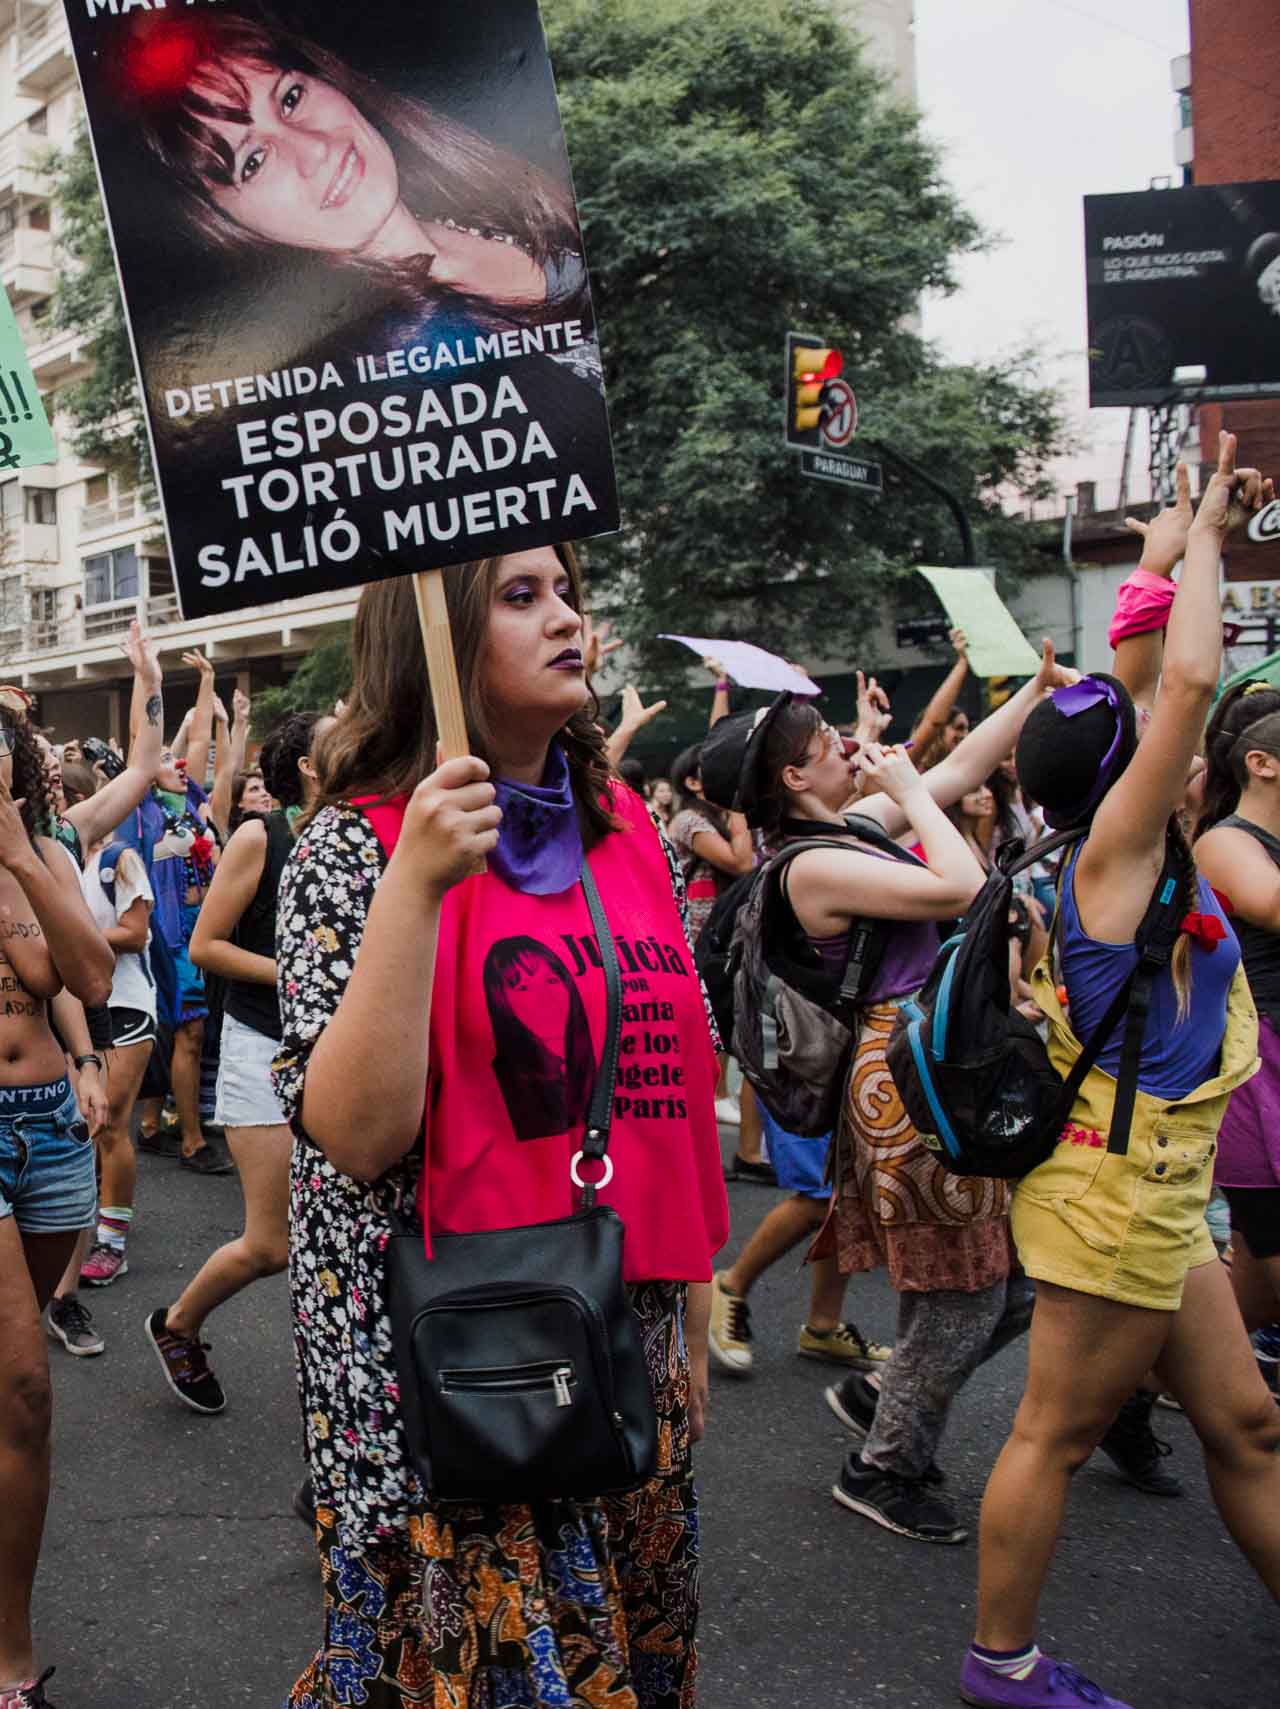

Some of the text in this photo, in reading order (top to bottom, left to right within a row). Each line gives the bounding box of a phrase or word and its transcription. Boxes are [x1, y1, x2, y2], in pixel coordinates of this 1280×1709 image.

[1103, 232, 1164, 251] PASIÓN
[165, 319, 586, 418] DETENIDA ILEGALMENTE
[237, 375, 528, 466] ESPOSADA
[222, 420, 558, 520] TORTURADA
[814, 456, 868, 481] PARAGUAY
[197, 473, 597, 588] SALIÓ MUERTA
[560, 934, 688, 977] Juicia
